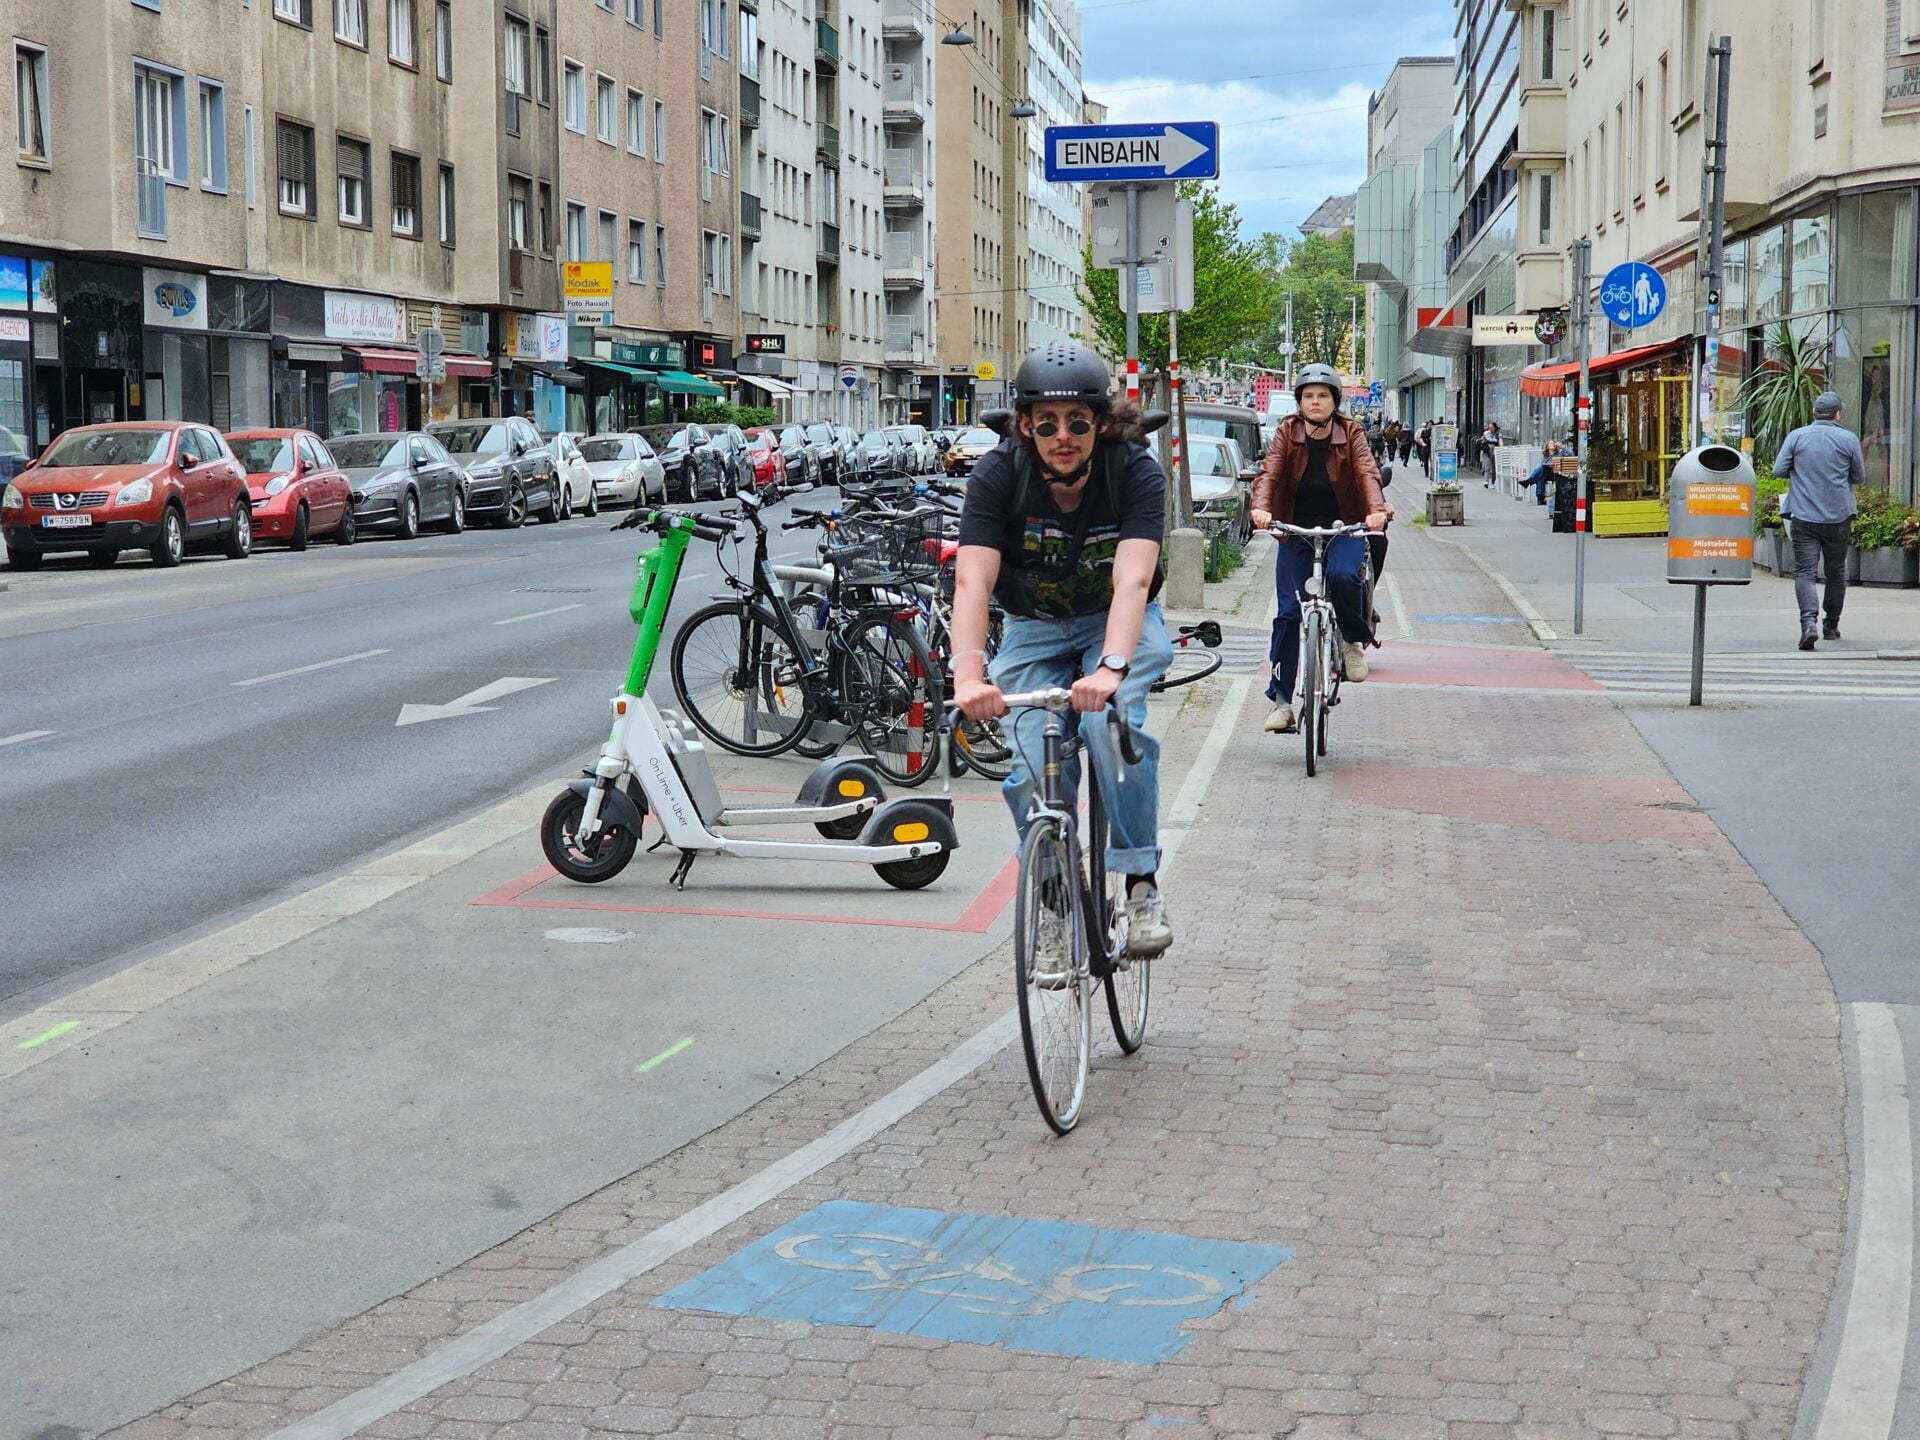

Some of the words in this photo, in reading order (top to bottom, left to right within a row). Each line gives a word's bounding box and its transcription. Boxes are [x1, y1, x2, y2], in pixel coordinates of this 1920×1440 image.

[1065, 140, 1160, 165] EINBAHN
[567, 279, 600, 288] Kodak
[326, 298, 348, 326] Nails
[369, 303, 394, 329] Studio
[0, 316, 26, 336] AGENCY
[517, 316, 531, 333] FOTO
[520, 336, 540, 352] Rausch
[761, 338, 782, 347] SHU
[1693, 539, 1738, 547] Misttelefon
[1703, 549, 1718, 557] 546
[1718, 549, 1729, 557] 48
[649, 757, 659, 774] On
[656, 771, 672, 796] Lime
[672, 802, 688, 826] Uber
